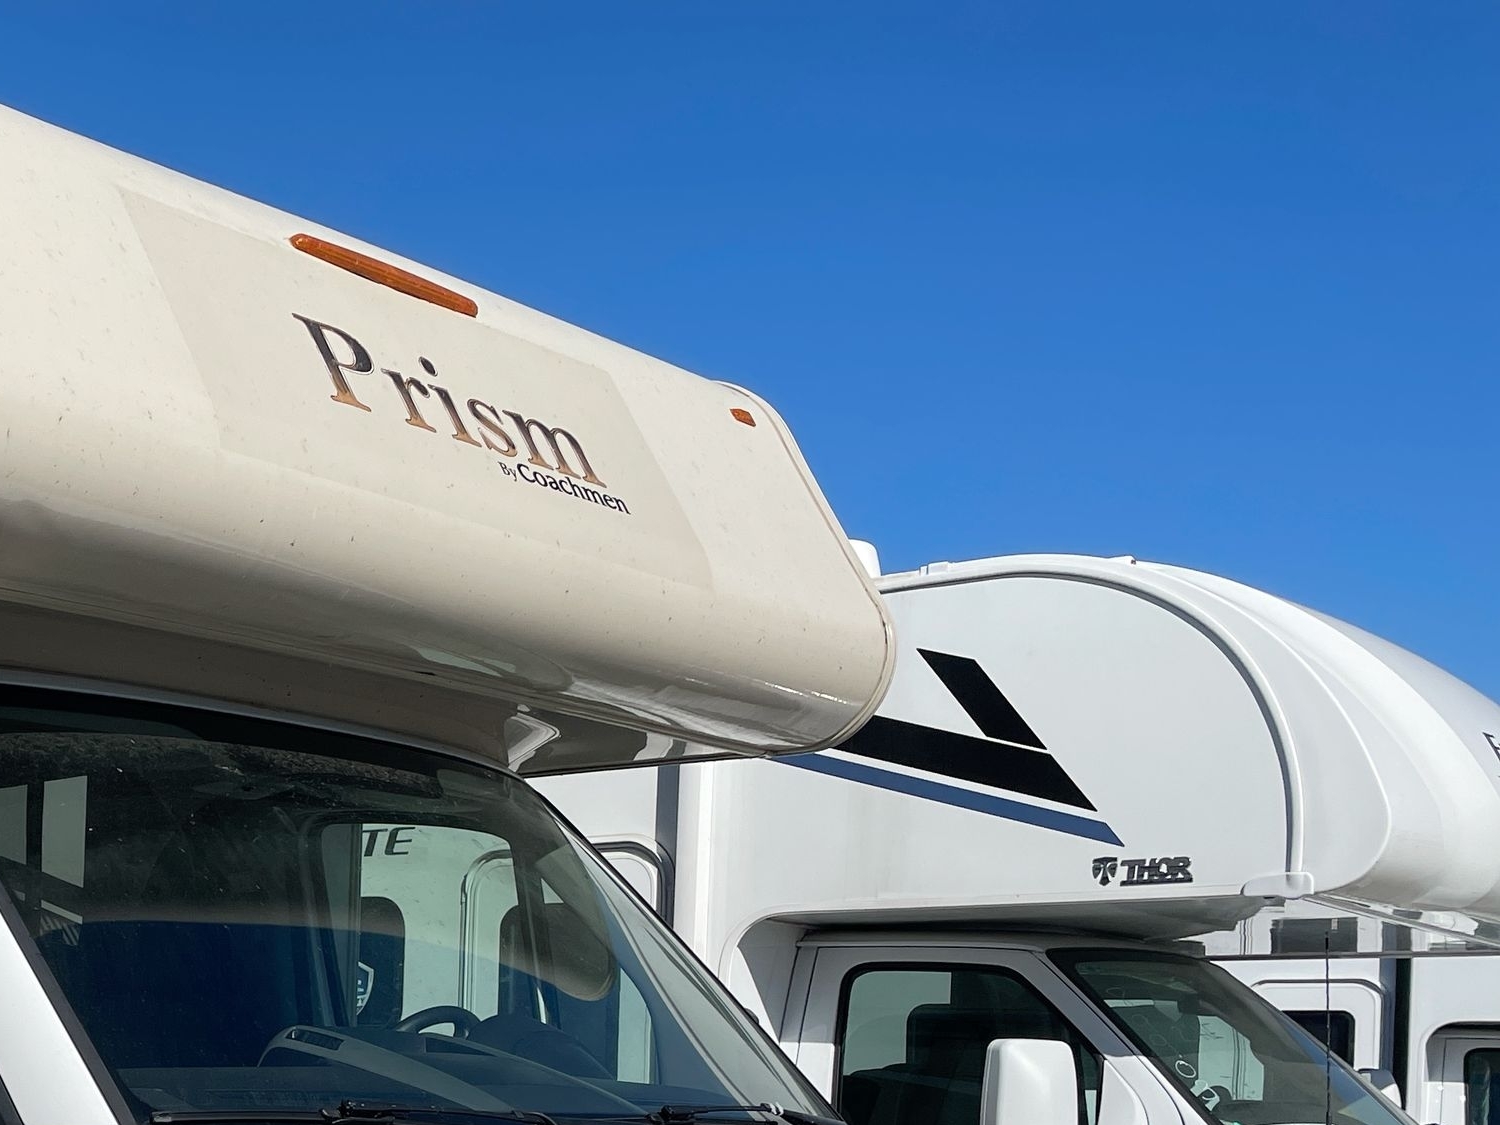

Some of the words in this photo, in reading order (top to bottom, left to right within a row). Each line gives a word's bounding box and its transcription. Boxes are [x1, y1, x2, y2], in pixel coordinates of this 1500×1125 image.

[291, 312, 607, 488] Prism
[497, 461, 517, 482] By
[516, 463, 631, 515] Coachmen
[1120, 856, 1194, 887] THOR
